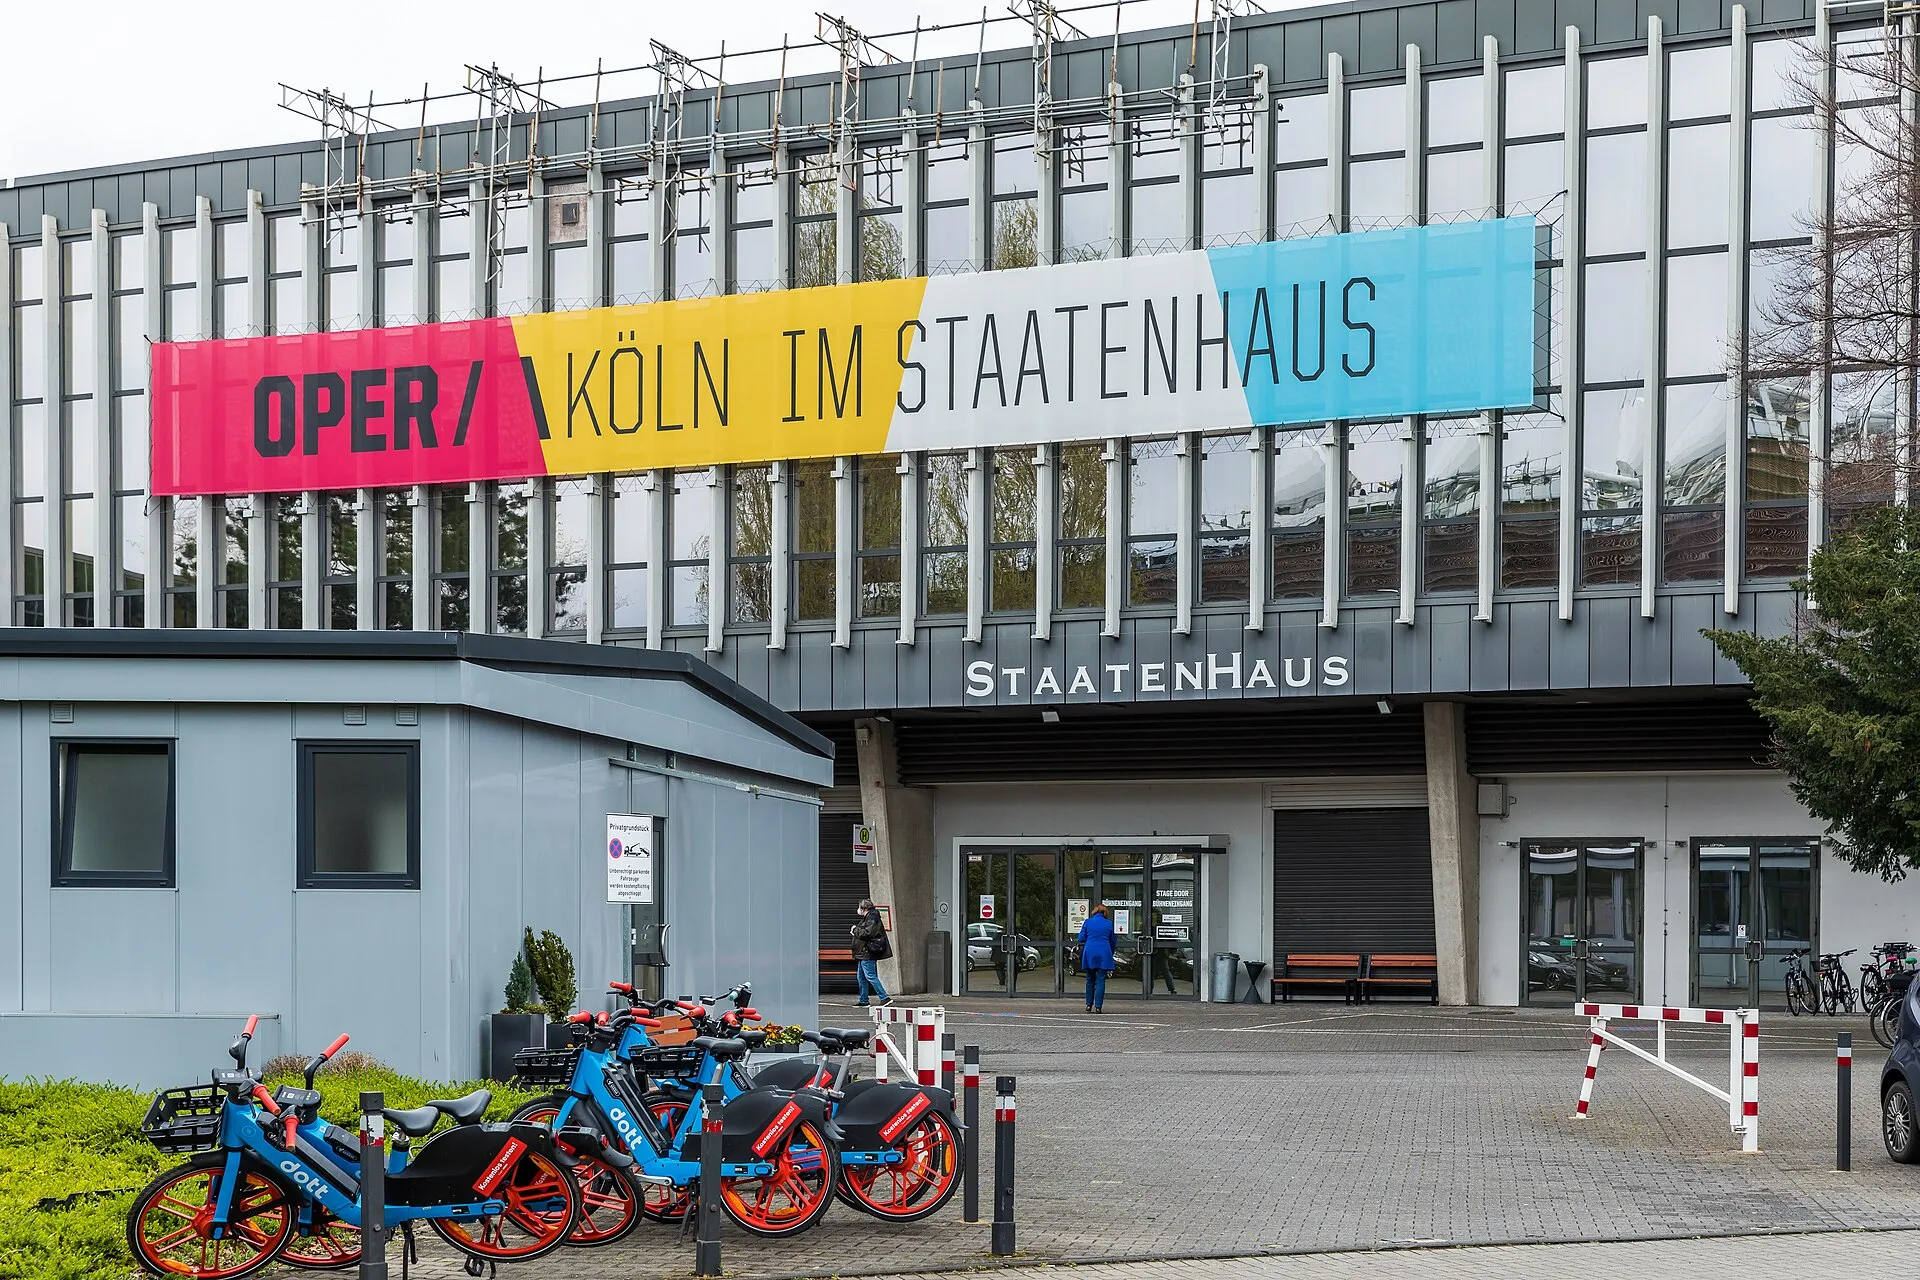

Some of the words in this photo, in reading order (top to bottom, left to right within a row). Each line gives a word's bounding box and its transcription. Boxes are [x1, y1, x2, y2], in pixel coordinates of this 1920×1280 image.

[781, 324, 863, 423] IM
[896, 276, 1376, 414] STAATENHAUS
[609, 823, 650, 833] Privatgrundstück
[1101, 898, 1142, 907] BÜHNENEINGANG
[1152, 899, 1193, 907] BÜHNENEINGANG
[1155, 889, 1173, 897] STAGE
[609, 1107, 643, 1151] dott
[755, 1125, 779, 1151] Kostenlos
[777, 1105, 795, 1126] testen!
[882, 1112, 907, 1137] Kostenlos
[906, 1096, 924, 1114] testen!
[280, 1160, 329, 1200] dott
[477, 1160, 503, 1191] Kostenlos
[499, 1141, 518, 1164] testen!
